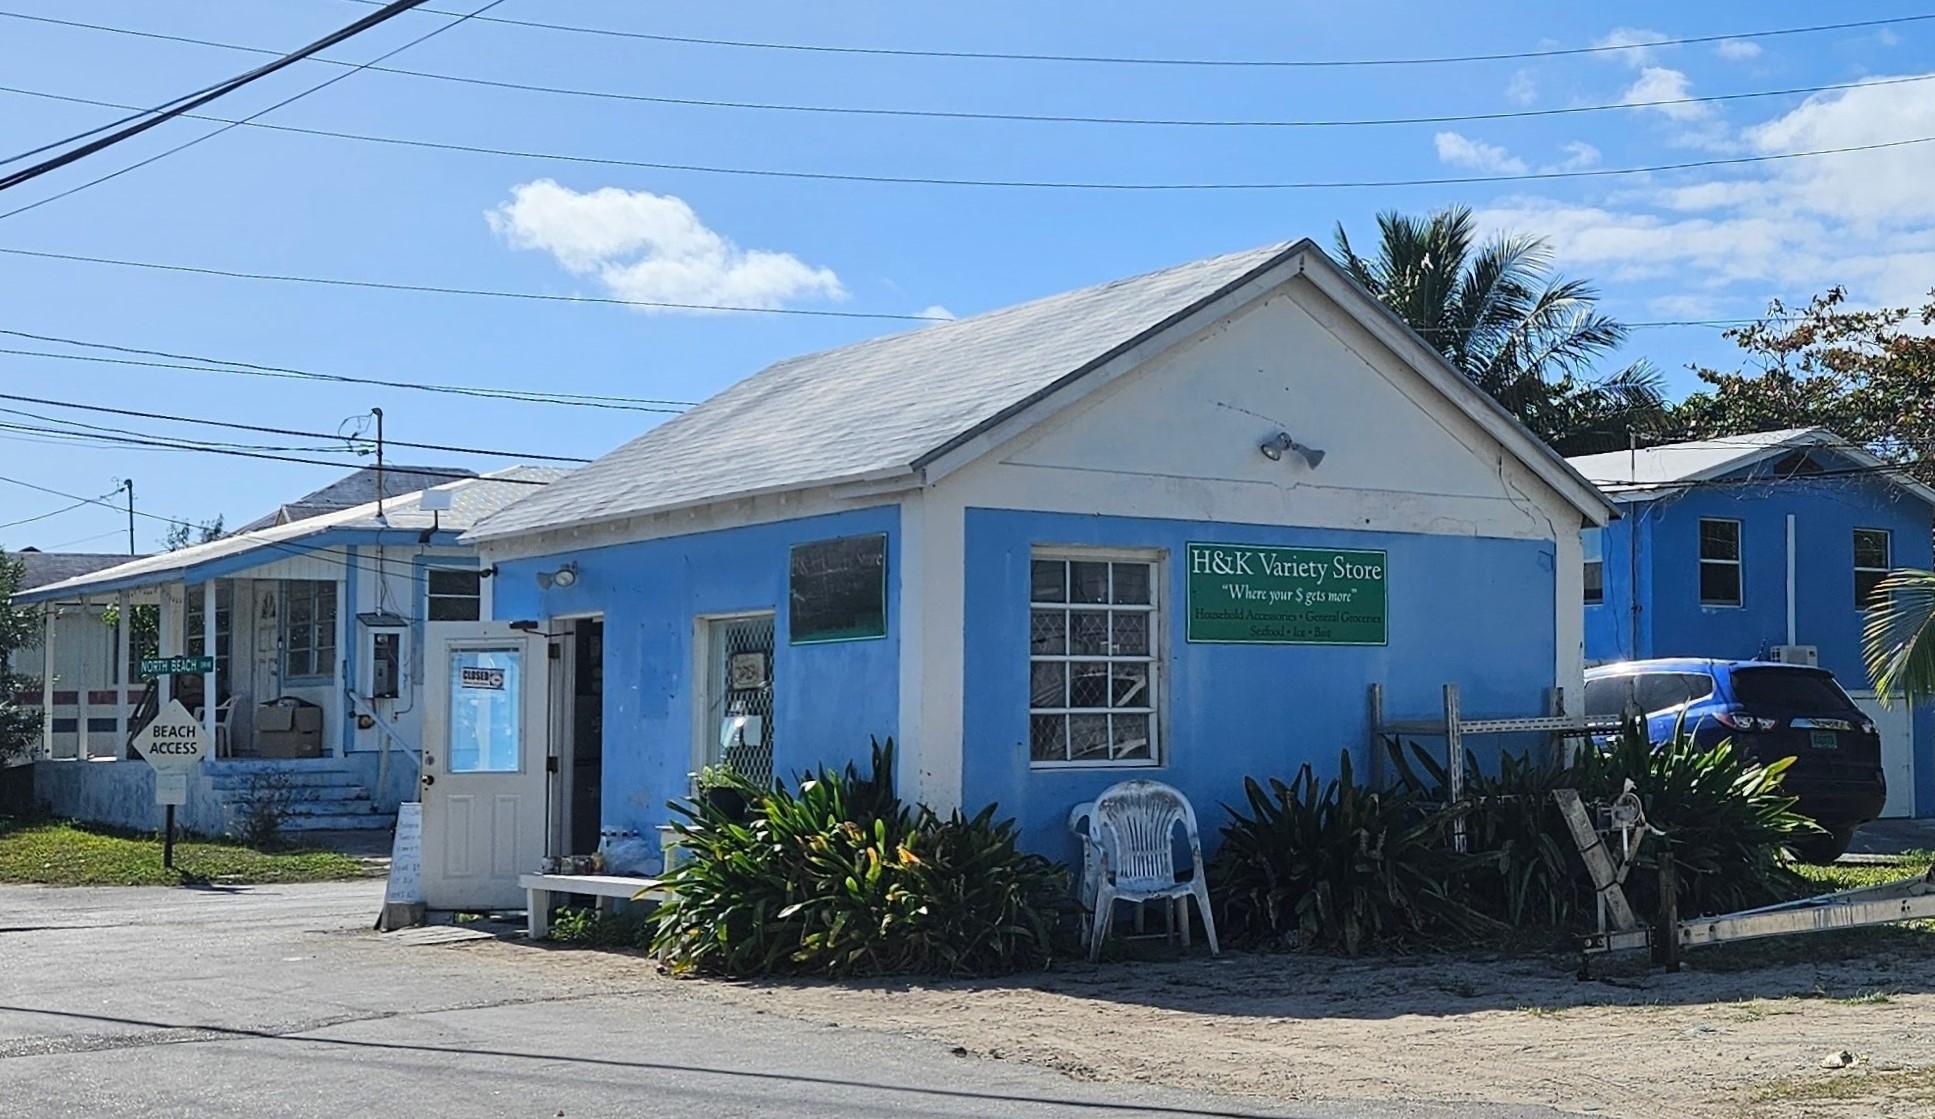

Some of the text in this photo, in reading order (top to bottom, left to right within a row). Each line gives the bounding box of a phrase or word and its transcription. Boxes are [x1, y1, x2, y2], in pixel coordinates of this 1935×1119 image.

[1192, 549, 1382, 585] H&K Variety Store
[1269, 589, 1293, 605] your
[1305, 590, 1326, 606] gets
[1195, 608, 1243, 620] Household
[1305, 611, 1339, 623] General
[1341, 612, 1382, 624] Groceries
[1249, 625, 1285, 637] Seafood
[141, 660, 168, 673] NORTH
[171, 659, 197, 672] BEACH
[463, 670, 489, 681] CLOSED
[153, 725, 196, 738] BEACH
[149, 742, 197, 755] ACCESS
